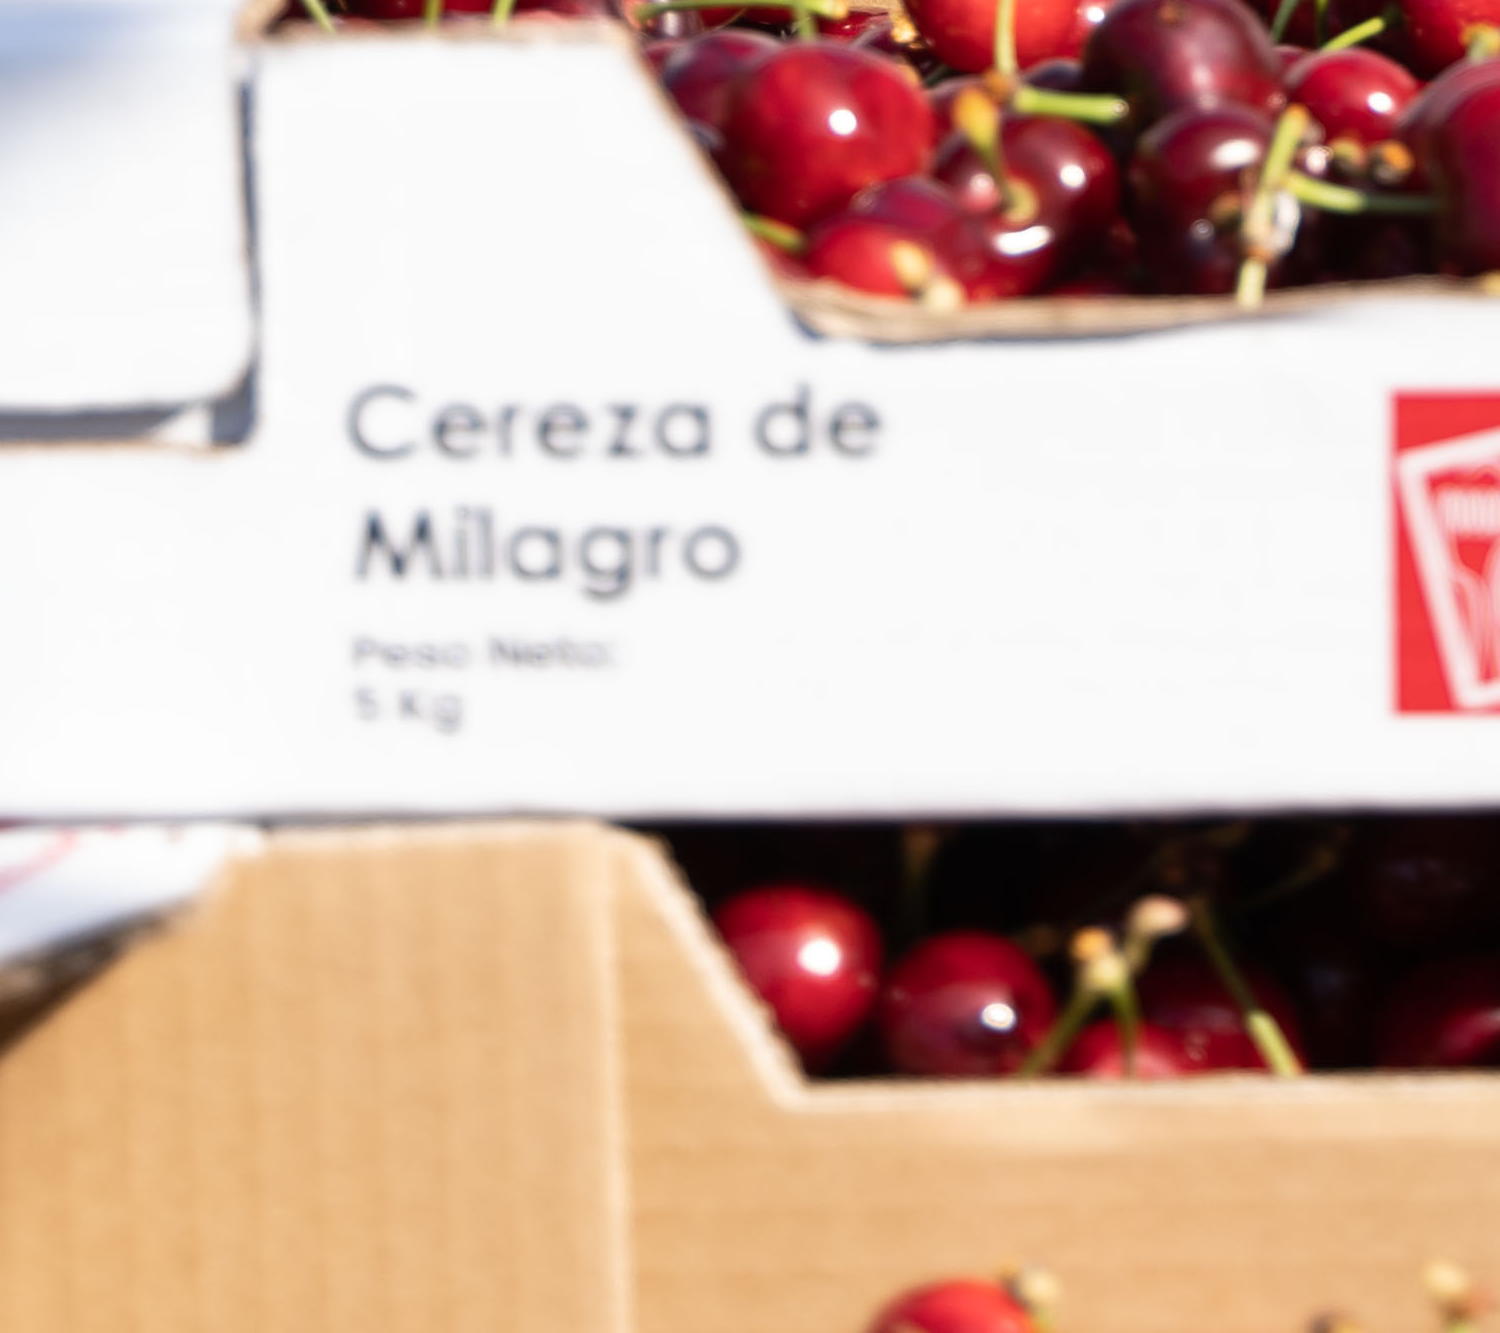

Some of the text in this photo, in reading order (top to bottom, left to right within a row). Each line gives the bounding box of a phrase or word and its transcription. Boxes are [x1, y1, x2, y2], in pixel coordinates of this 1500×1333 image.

[345, 381, 884, 463] Cereza de
[353, 505, 742, 604] Milagro
